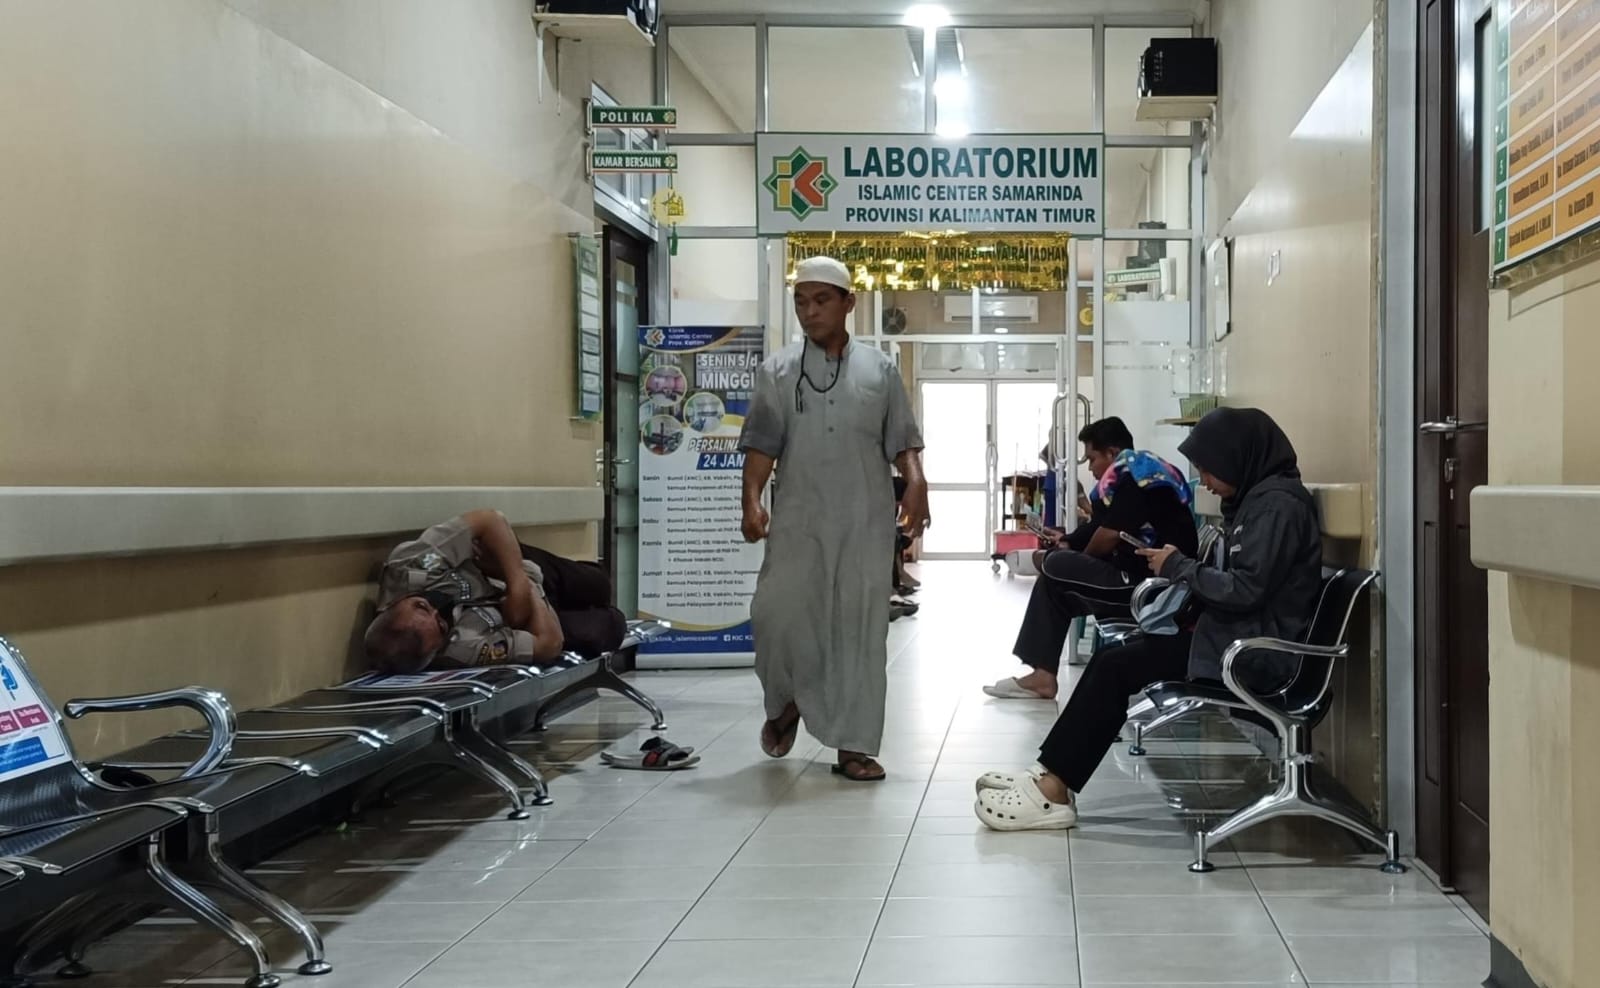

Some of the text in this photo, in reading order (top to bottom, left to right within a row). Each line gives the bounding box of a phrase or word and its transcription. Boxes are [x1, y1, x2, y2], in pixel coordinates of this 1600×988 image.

[600, 112, 654, 122] POLI KIA
[594, 156, 661, 167] KAMAR BERSALIN
[844, 146, 1097, 178] LABORATORIUM
[858, 184, 1083, 201] ISLAMIC CENTER SAMARINDA
[846, 207, 1096, 223] PROVINSI KALIMANTAN TIMUR
[869, 247, 927, 260] RAMADHAN
[701, 354, 736, 367] SENIN
[701, 372, 754, 389] MINGG
[703, 455, 717, 468] 24
